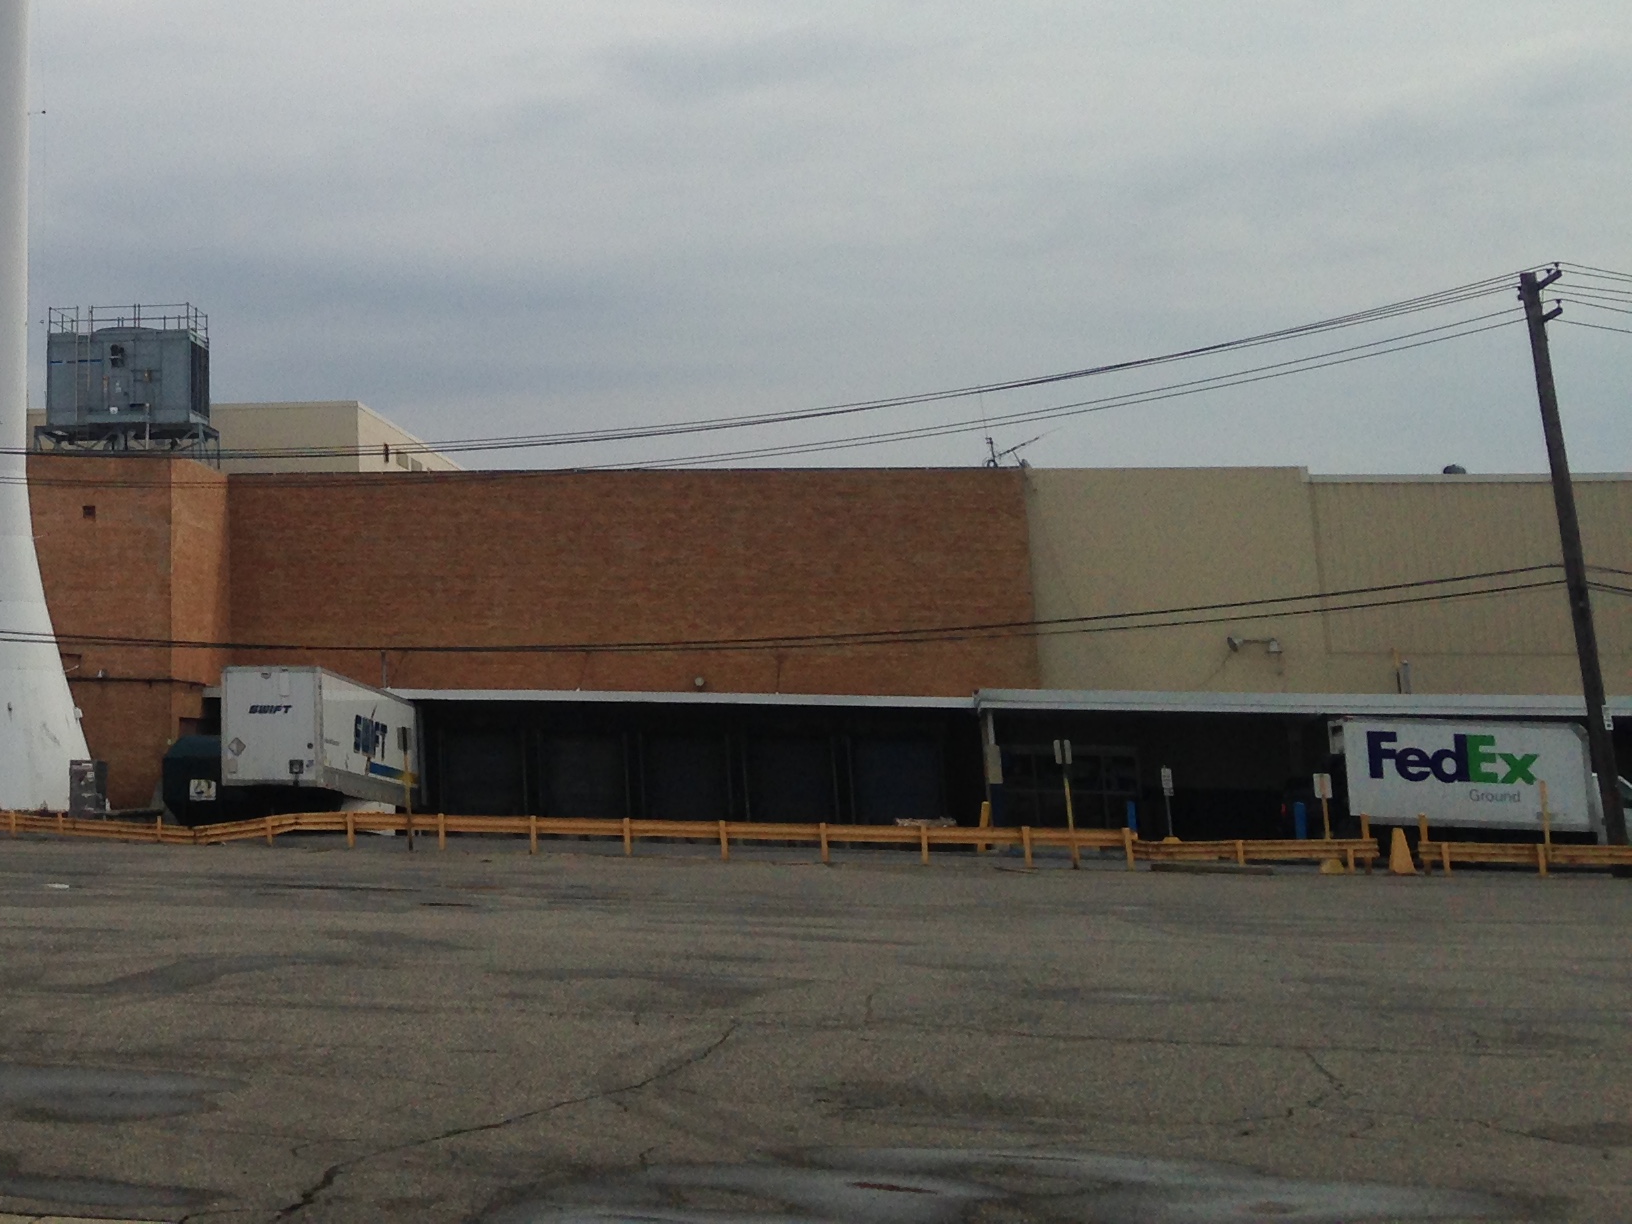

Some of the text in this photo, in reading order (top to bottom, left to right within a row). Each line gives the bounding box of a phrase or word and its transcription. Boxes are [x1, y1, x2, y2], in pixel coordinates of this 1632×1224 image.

[248, 704, 293, 715] SWIFT
[1366, 731, 1540, 786] FedEx
[1469, 788, 1521, 804] Ground
